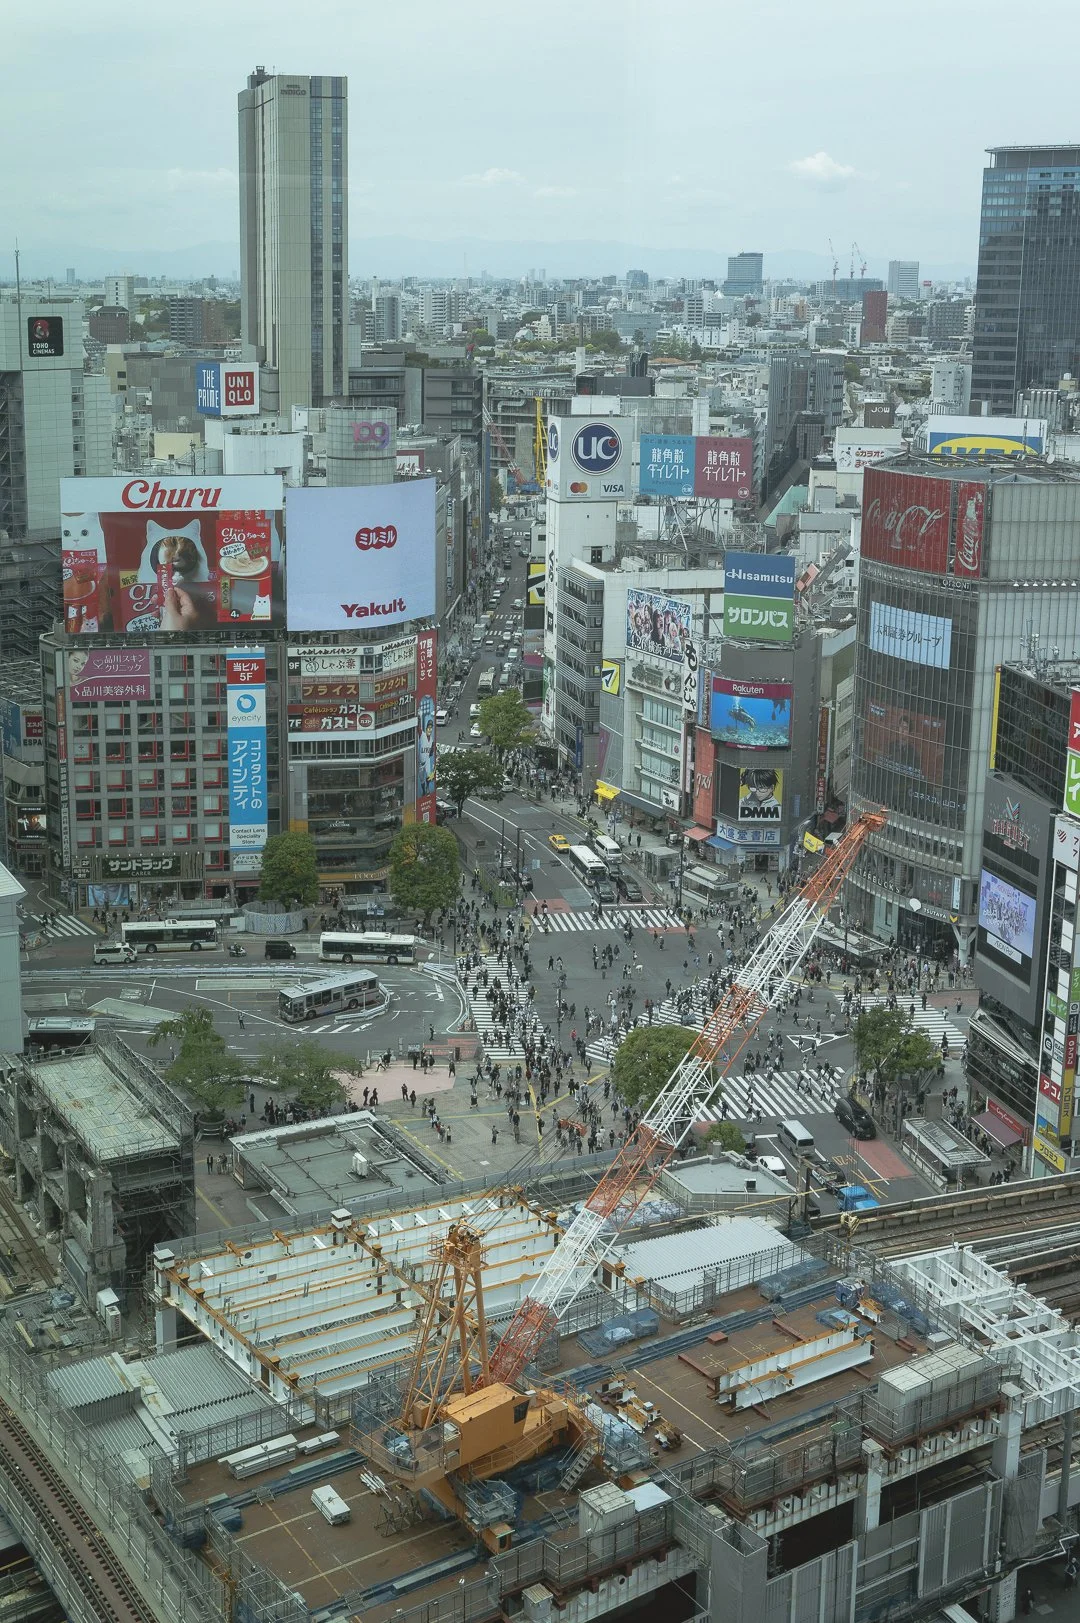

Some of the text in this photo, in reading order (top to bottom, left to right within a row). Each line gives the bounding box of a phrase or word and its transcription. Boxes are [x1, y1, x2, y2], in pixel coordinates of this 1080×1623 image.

[202, 370, 215, 388] THE
[228, 376, 249, 388] UNI
[198, 389, 219, 408] PRIME
[228, 390, 251, 404] QLO
[351, 422, 390, 449] 109
[651, 447, 685, 464] 龍角散
[707, 450, 741, 466] 龍角散
[647, 464, 690, 480] ダイレクト
[702, 466, 747, 483] ダイレクト
[121, 479, 222, 509] Churu
[603, 484, 624, 493] VISA
[359, 530, 396, 546] ミルミル
[725, 568, 794, 584] Hisamitsu
[340, 597, 407, 618] Yakult
[727, 606, 789, 629] サロンパス
[296, 647, 358, 656] しゃぶしゃぶバイキング
[233, 662, 260, 672] 当ビル
[288, 661, 300, 669] 9F
[321, 658, 356, 670] しゃぶ葉
[239, 672, 253, 681] 5F
[81, 684, 147, 697] 品川美容外科
[732, 683, 764, 695] Rakuten
[338, 704, 366, 715] ガスト
[231, 714, 262, 724] eyecity
[288, 719, 302, 728] 7F
[320, 716, 355, 730] ガスト
[231, 740, 249, 810] アイシティ
[250, 740, 263, 809] コンタクトの
[739, 806, 780, 819] DMM
[108, 858, 174, 872] サンドラッグ
[923, 908, 947, 919] TSUTAYA
